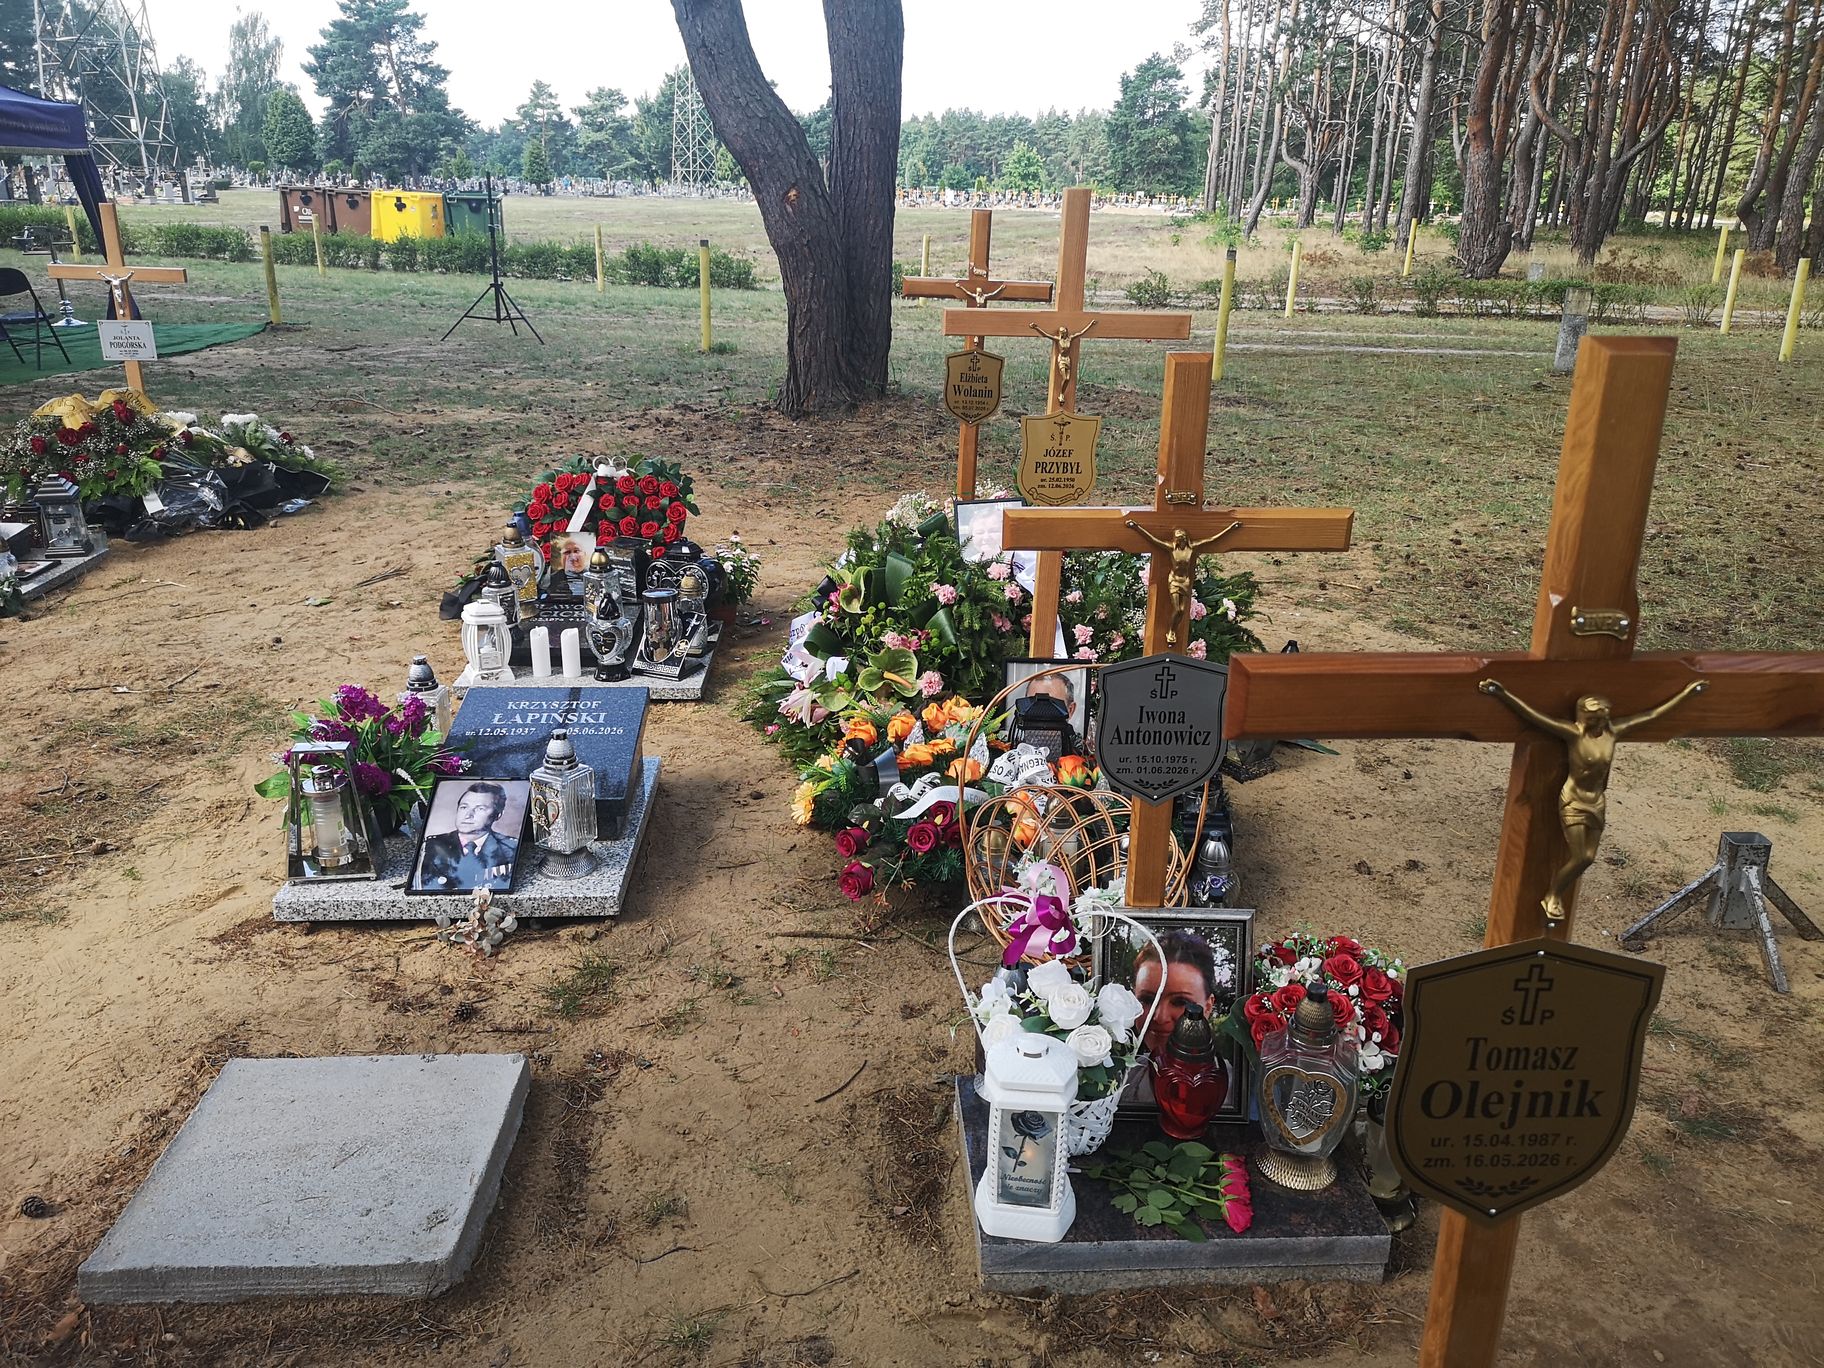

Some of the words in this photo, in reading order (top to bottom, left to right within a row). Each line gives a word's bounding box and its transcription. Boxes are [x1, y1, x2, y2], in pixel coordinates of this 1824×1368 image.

[960, 372, 988, 383] Elżbieta
[952, 384, 993, 398] Wolanin
[1043, 446, 1074, 458] JÓZEF
[1034, 461, 1082, 474] PRZYBYŁ
[1170, 690, 1178, 699] P
[507, 701, 602, 710] KRZYSZTOF
[490, 710, 607, 724] ŁAPIŃSKI
[1137, 705, 1186, 724] Iwona
[478, 727, 536, 736] 12.05.1937
[566, 727, 624, 735] 05.06.2026
[1110, 724, 1212, 747] Antonowicz
[1135, 755, 1188, 763] 15.10.1975
[1136, 766, 1189, 774] 01.06.2026
[1501, 1006, 1515, 1025] Ś
[1539, 1010, 1554, 1025] P
[1466, 1037, 1579, 1072] Tomasz
[1420, 1079, 1606, 1130] Olejnik
[1430, 1137, 1454, 1148] ur.
[1462, 1133, 1561, 1147] 15.04.1987
[1565, 1135, 1577, 1146] r.
[1423, 1157, 1456, 1168] zm.
[1463, 1153, 1561, 1168] 16.05.2026
[1565, 1155, 1578, 1167] r.
